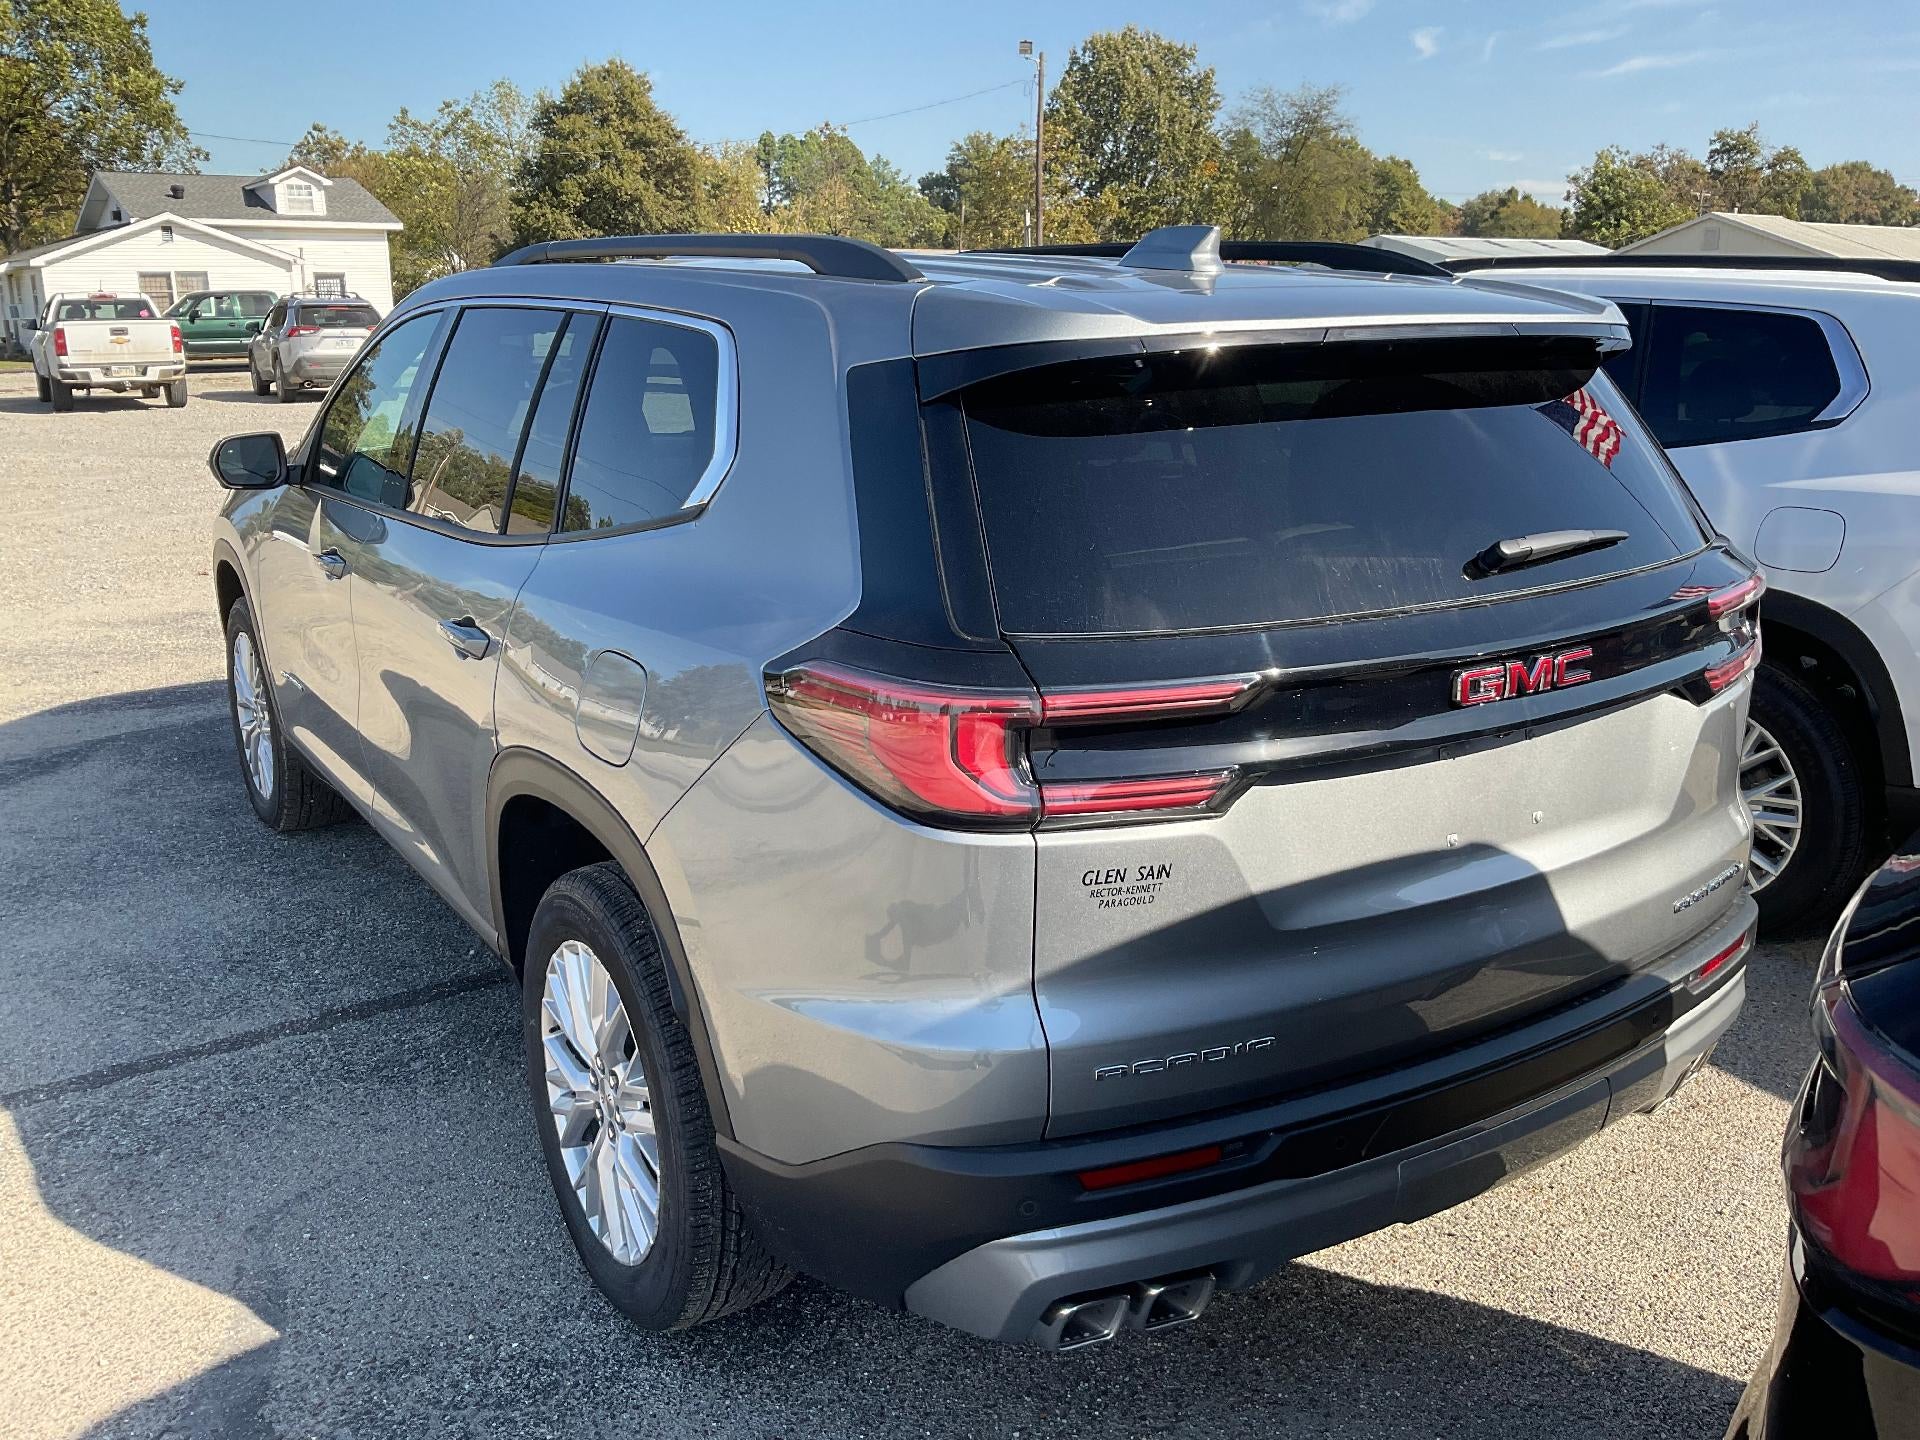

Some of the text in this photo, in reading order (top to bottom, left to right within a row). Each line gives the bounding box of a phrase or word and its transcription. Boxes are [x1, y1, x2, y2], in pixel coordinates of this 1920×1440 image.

[1453, 648, 1592, 705] GMC
[1081, 863, 1172, 886] GLEN SAIN
[1089, 883, 1164, 898] RECTOR-KENNETT
[1098, 895, 1155, 909] PARAGOULD
[1095, 1036, 1277, 1080] ACADIA
